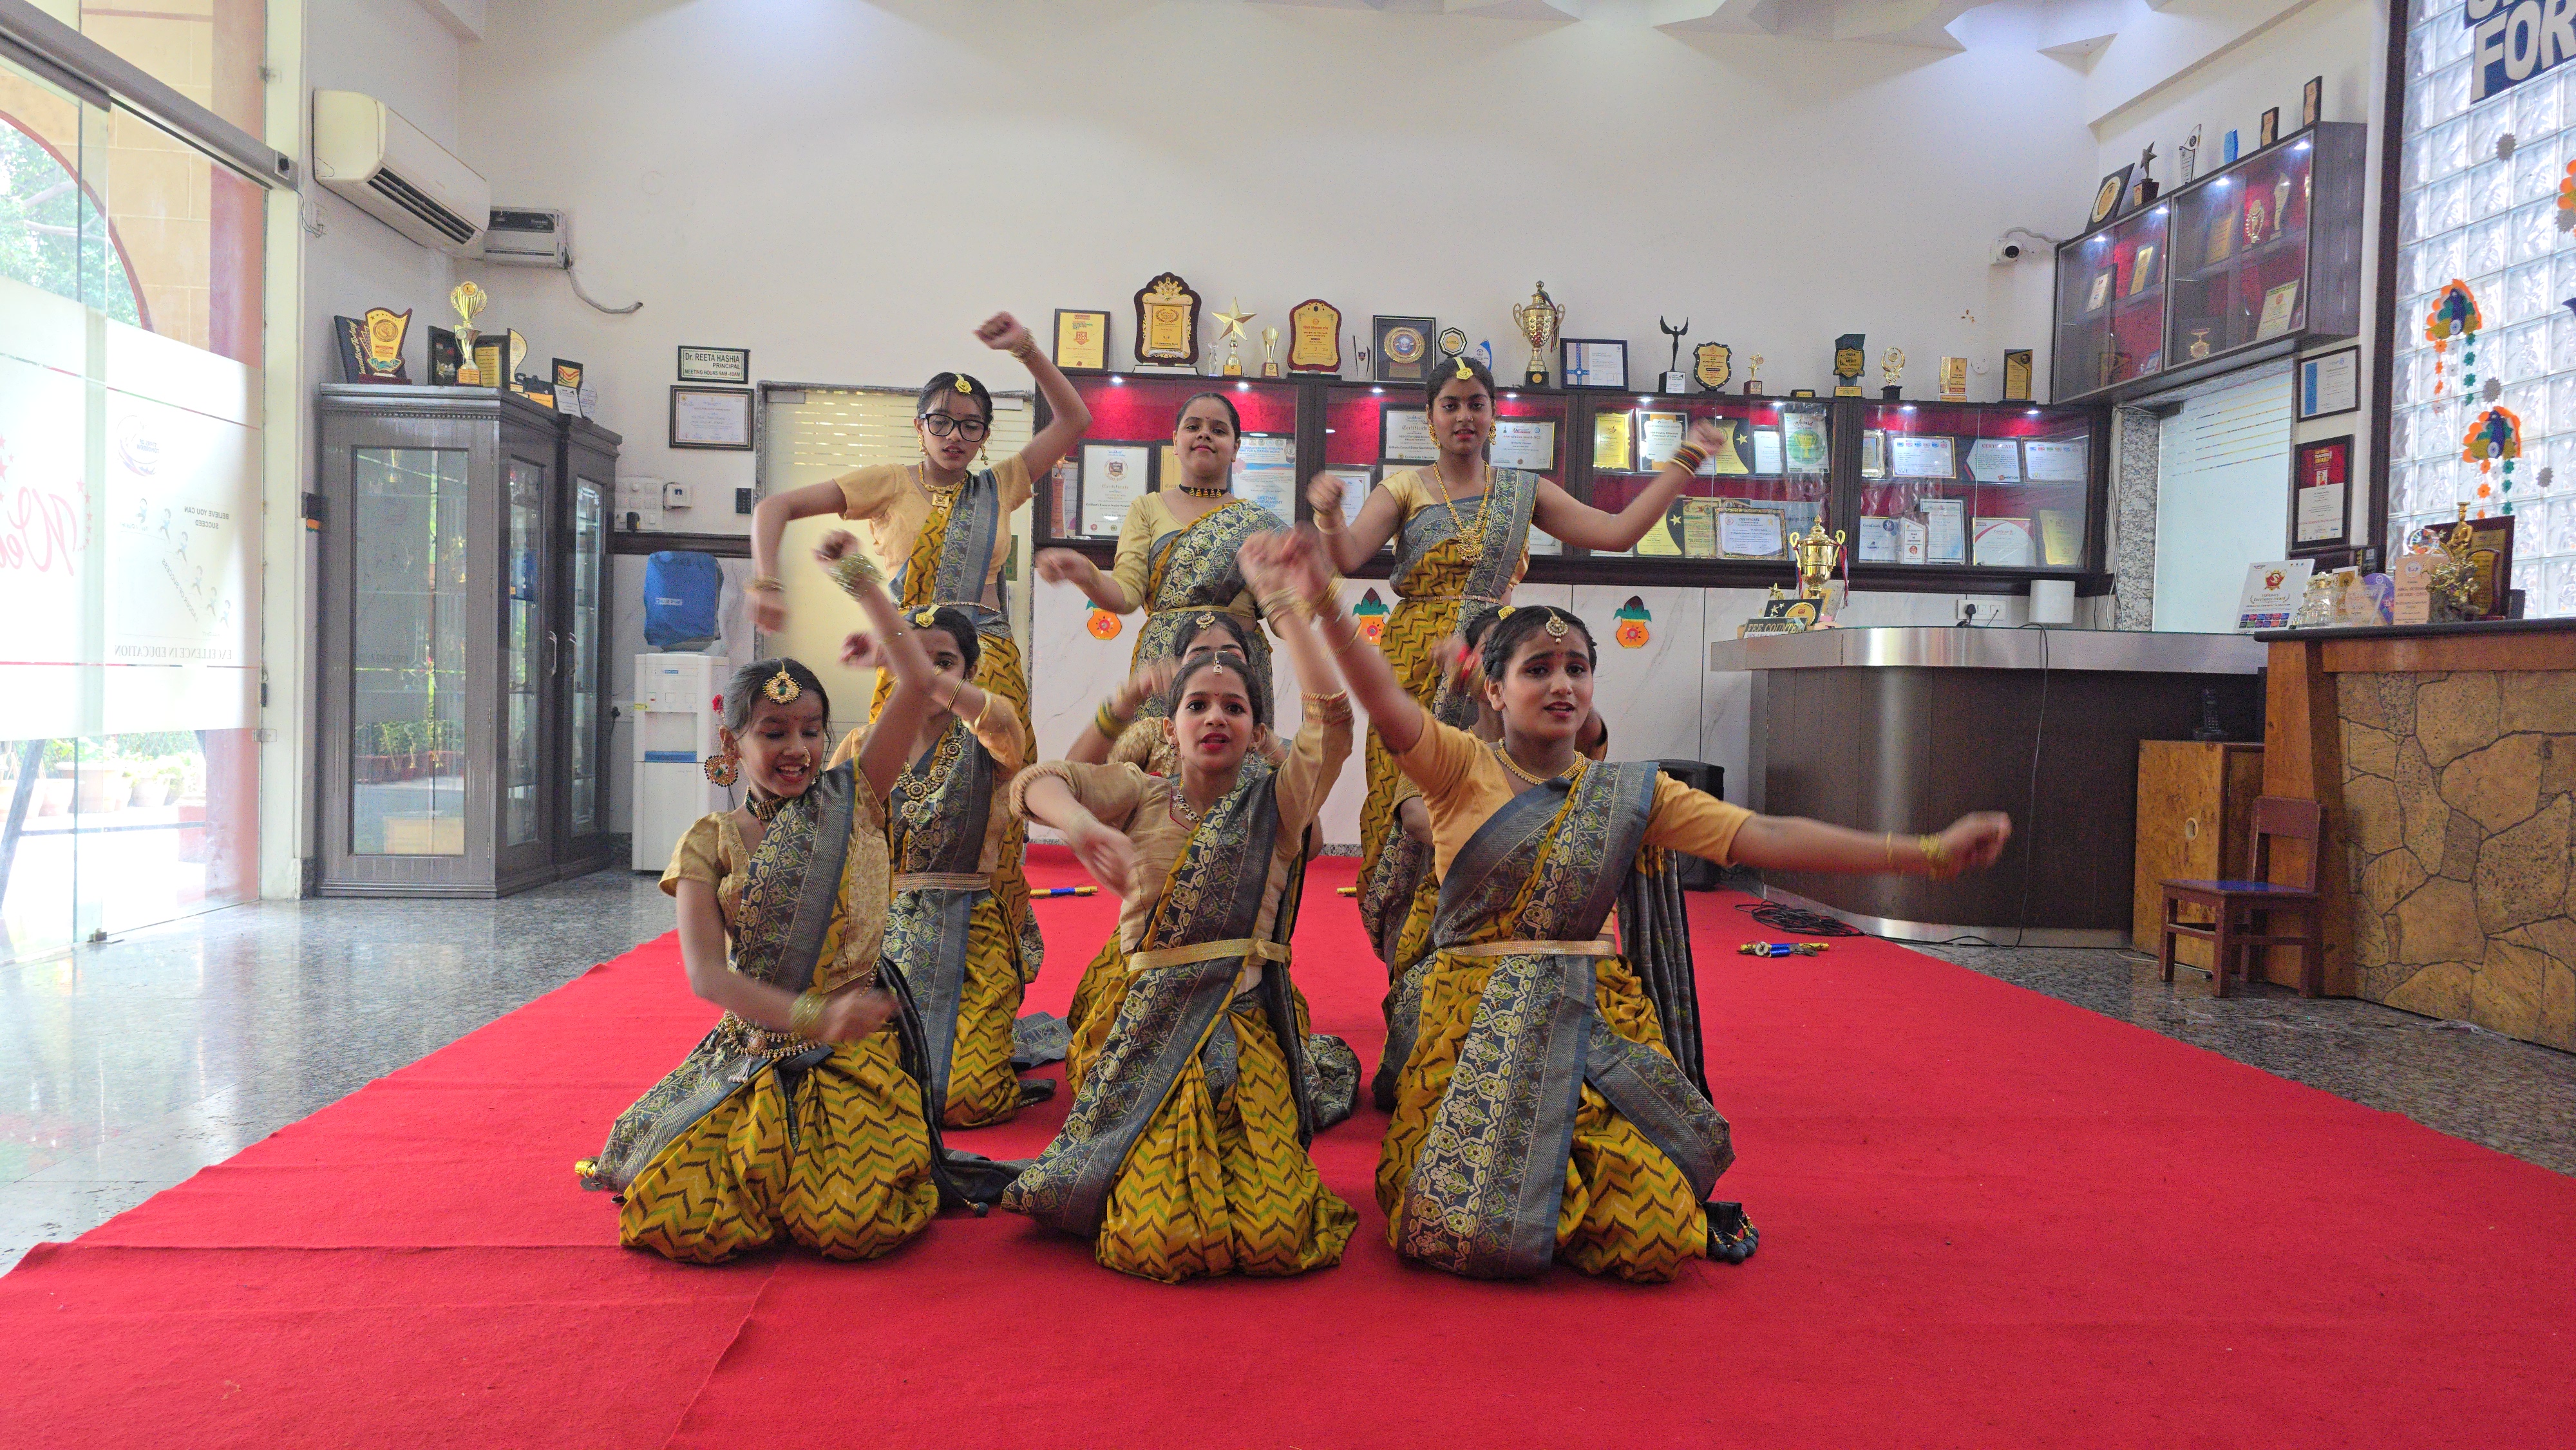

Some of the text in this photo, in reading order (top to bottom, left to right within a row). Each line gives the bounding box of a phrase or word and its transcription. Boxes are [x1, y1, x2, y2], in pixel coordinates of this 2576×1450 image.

[2470, 0, 2576, 105] FOR
[695, 353, 715, 362] REETA
[716, 354, 740, 363] HASHIA
[1747, 623, 1804, 634] FEE COUNTER
